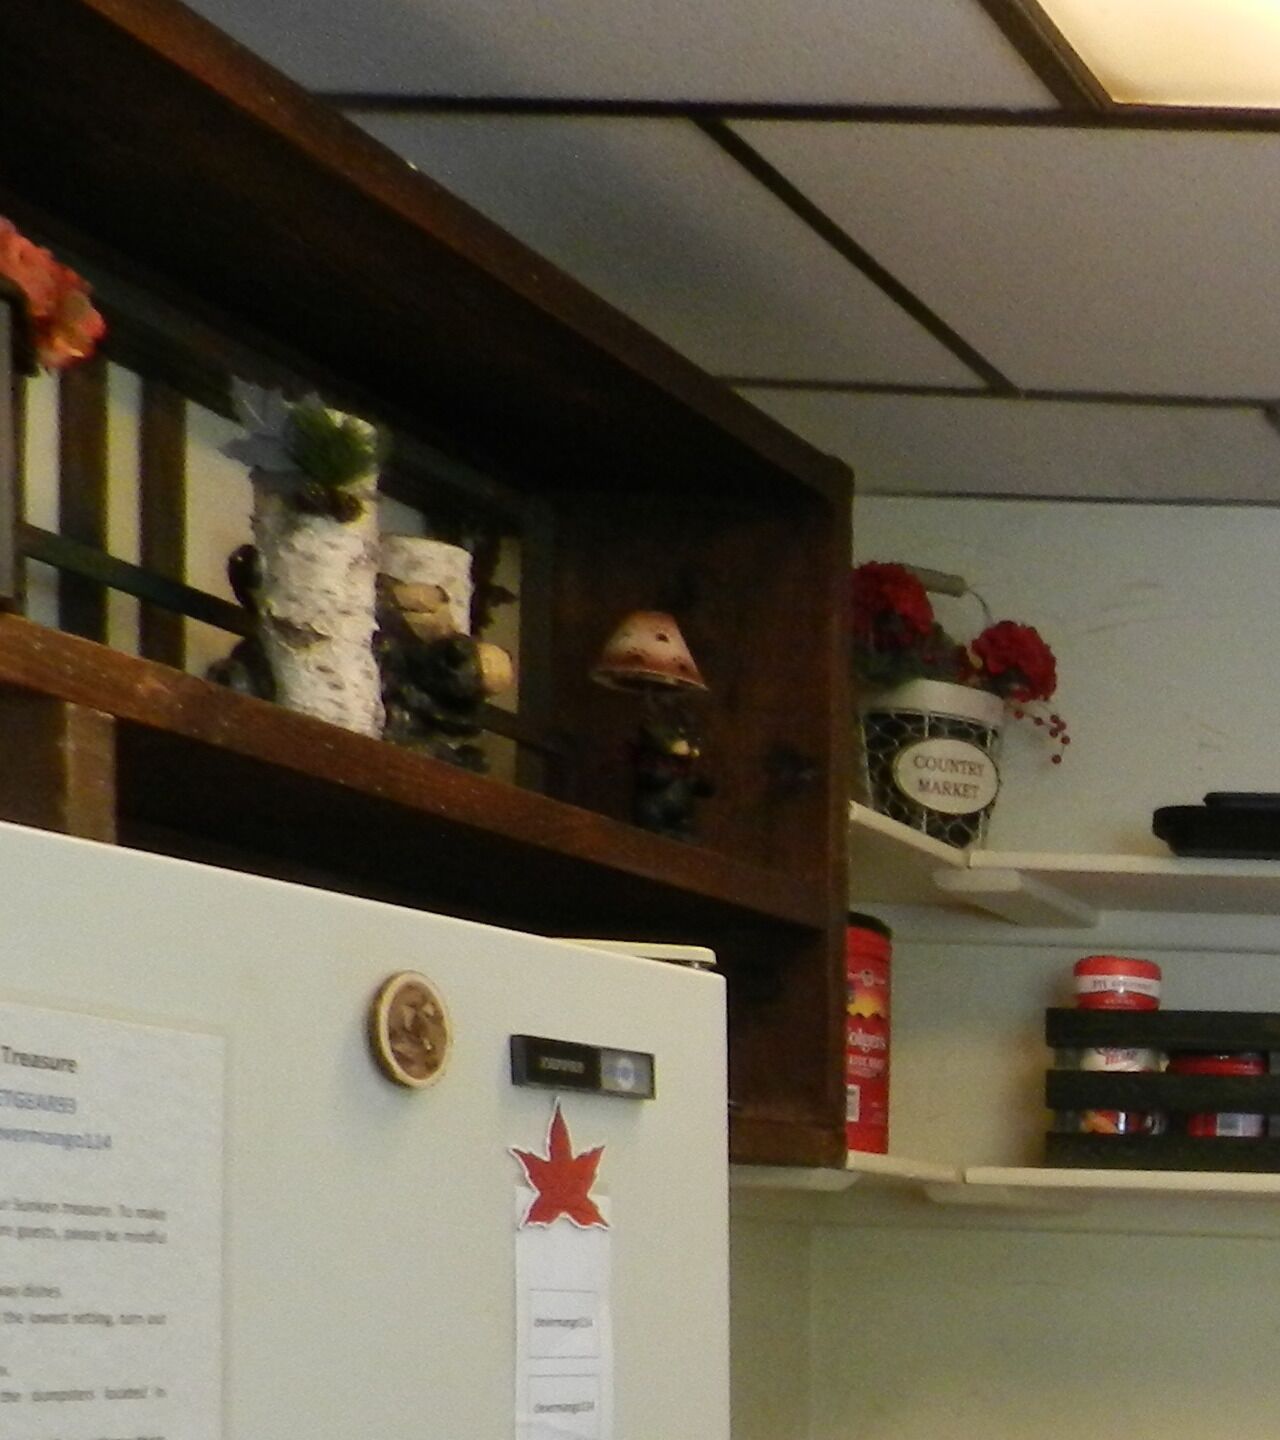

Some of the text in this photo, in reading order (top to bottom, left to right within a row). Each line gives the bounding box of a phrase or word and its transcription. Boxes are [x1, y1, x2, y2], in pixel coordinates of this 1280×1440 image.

[913, 755, 984, 776] COUNTRY
[918, 778, 979, 799] MARKET
[1, 1045, 77, 1073] Treasure
